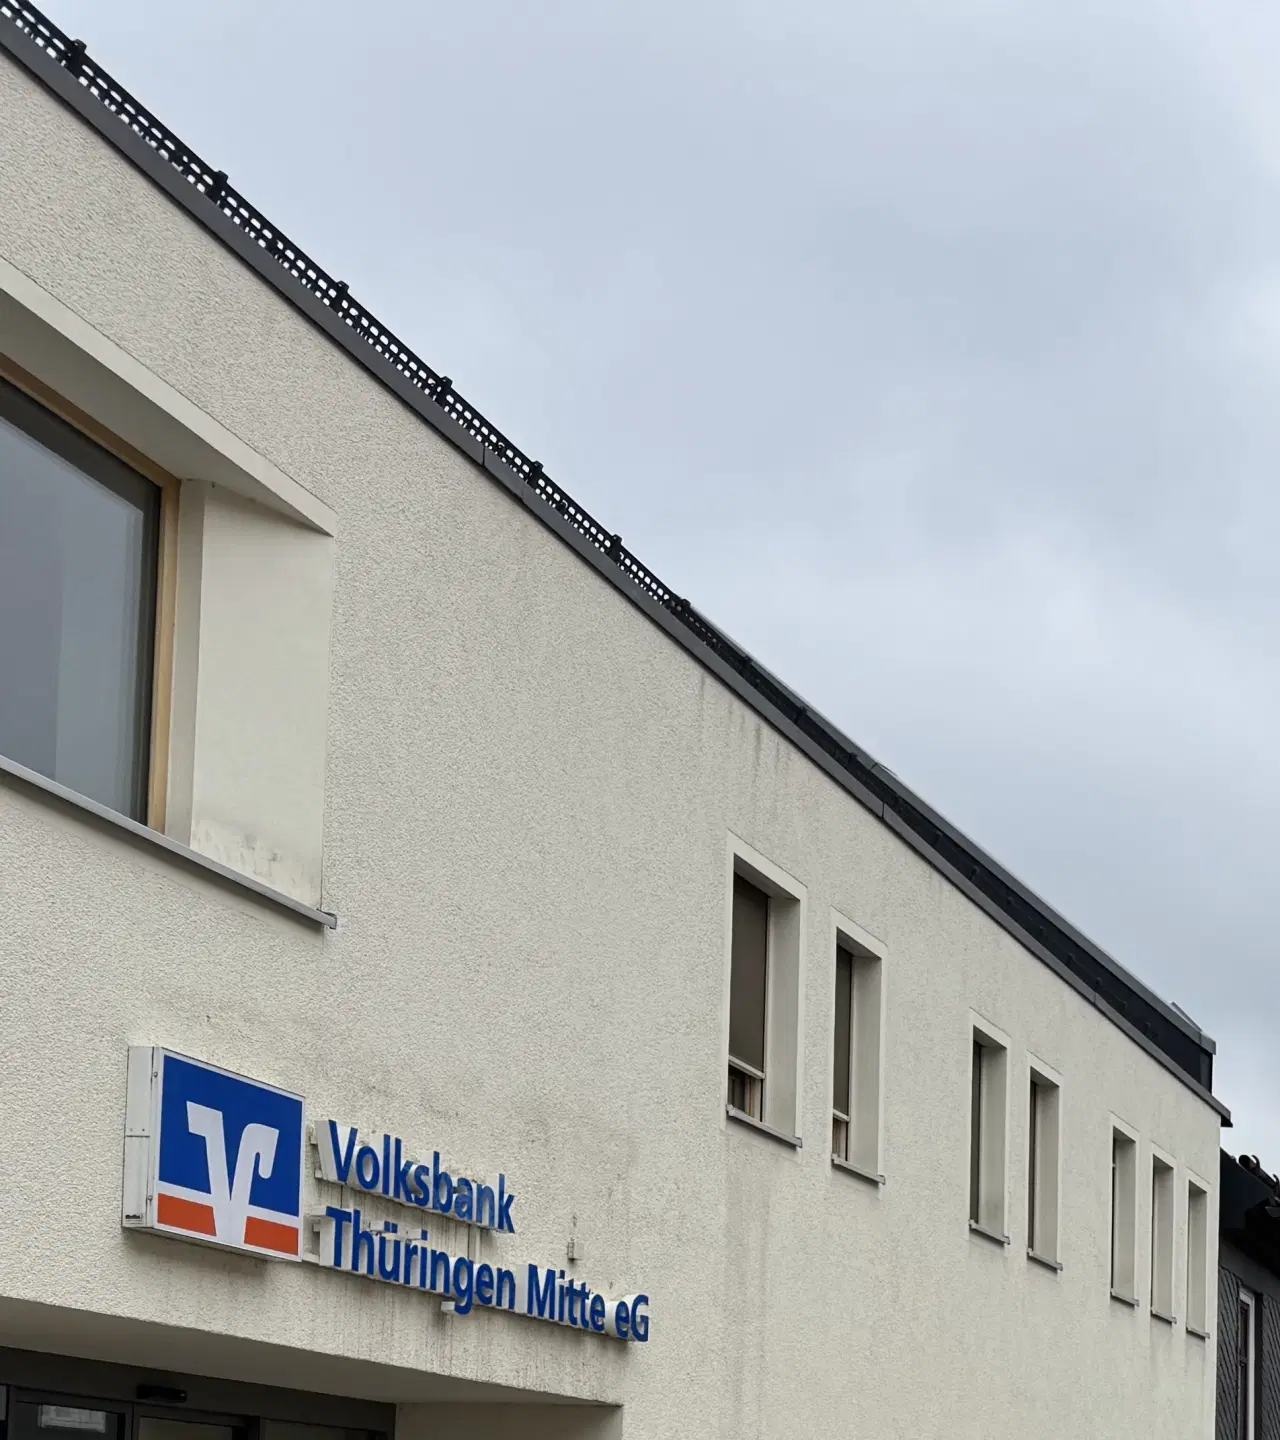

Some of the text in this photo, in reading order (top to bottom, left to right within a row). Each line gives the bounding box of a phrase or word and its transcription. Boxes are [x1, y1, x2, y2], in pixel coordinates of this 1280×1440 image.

[328, 1119, 515, 1234] Volksbank
[326, 1205, 649, 1342] Thüringen Mitte eG
